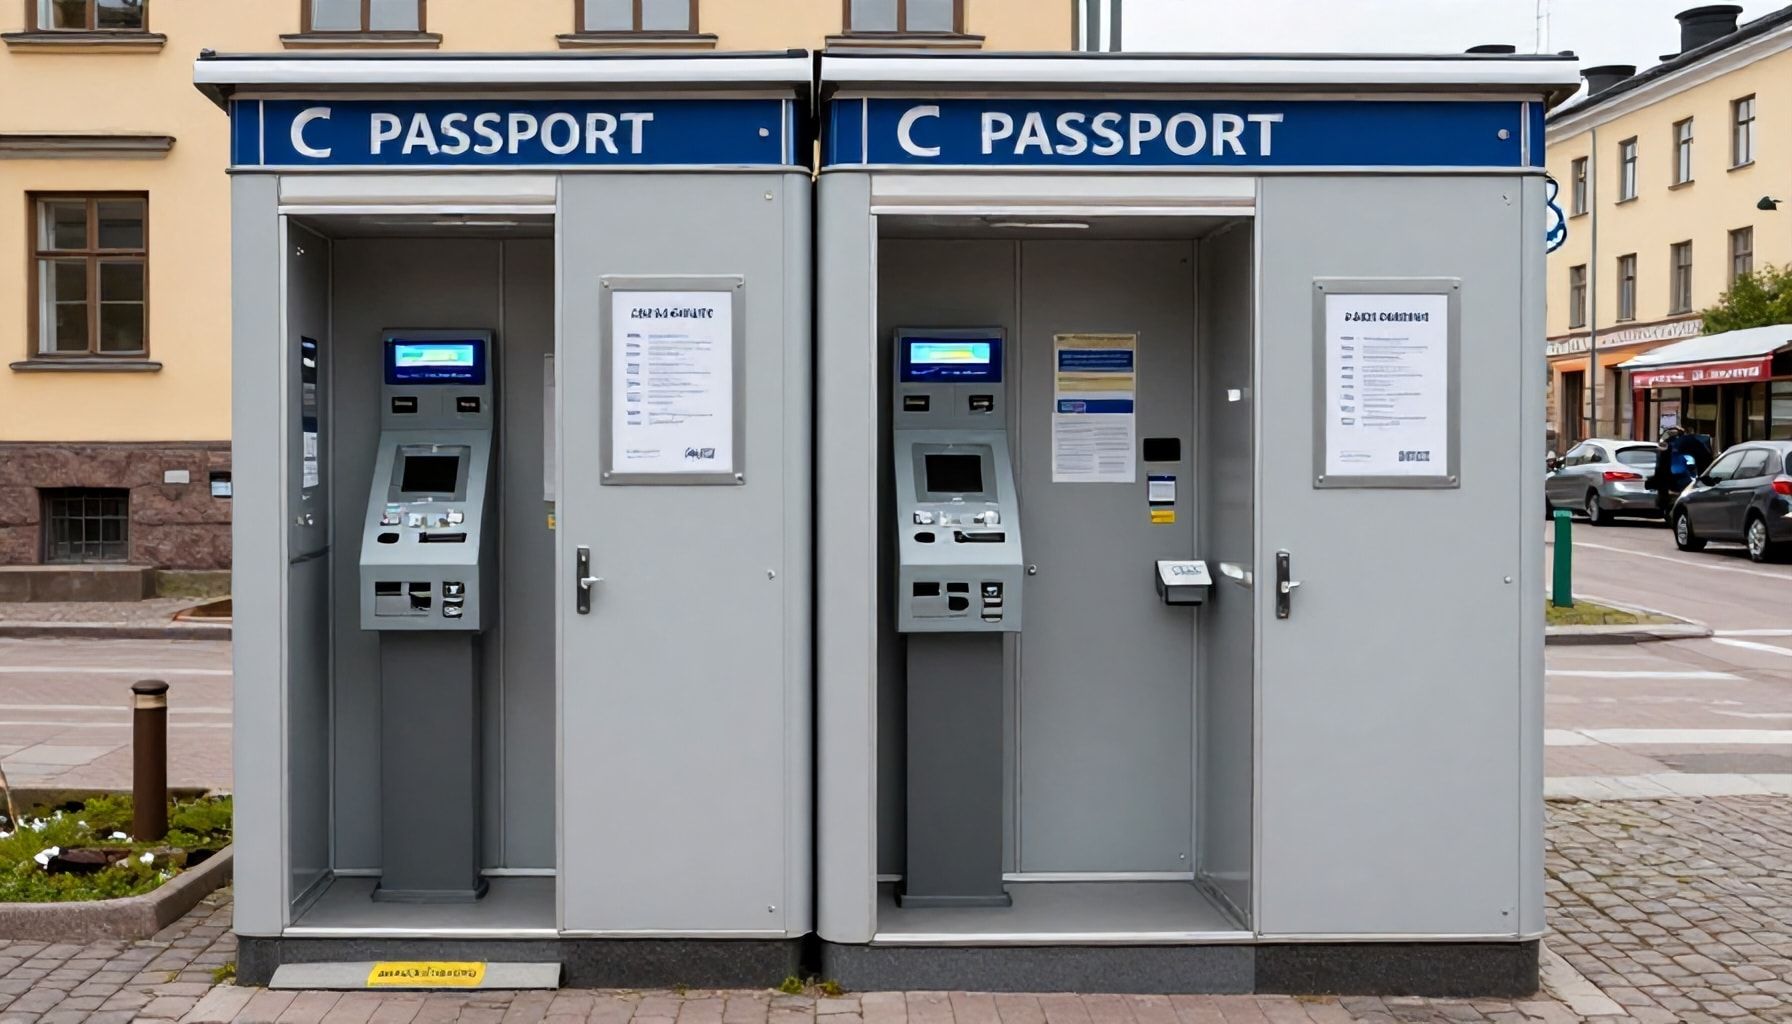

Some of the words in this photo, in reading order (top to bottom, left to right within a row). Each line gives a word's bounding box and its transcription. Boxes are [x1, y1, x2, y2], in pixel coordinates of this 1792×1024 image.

[289, 106, 332, 159] C
[369, 111, 655, 156] PASSPORT
[896, 104, 941, 158] C
[980, 111, 1285, 157] PASSPORT
